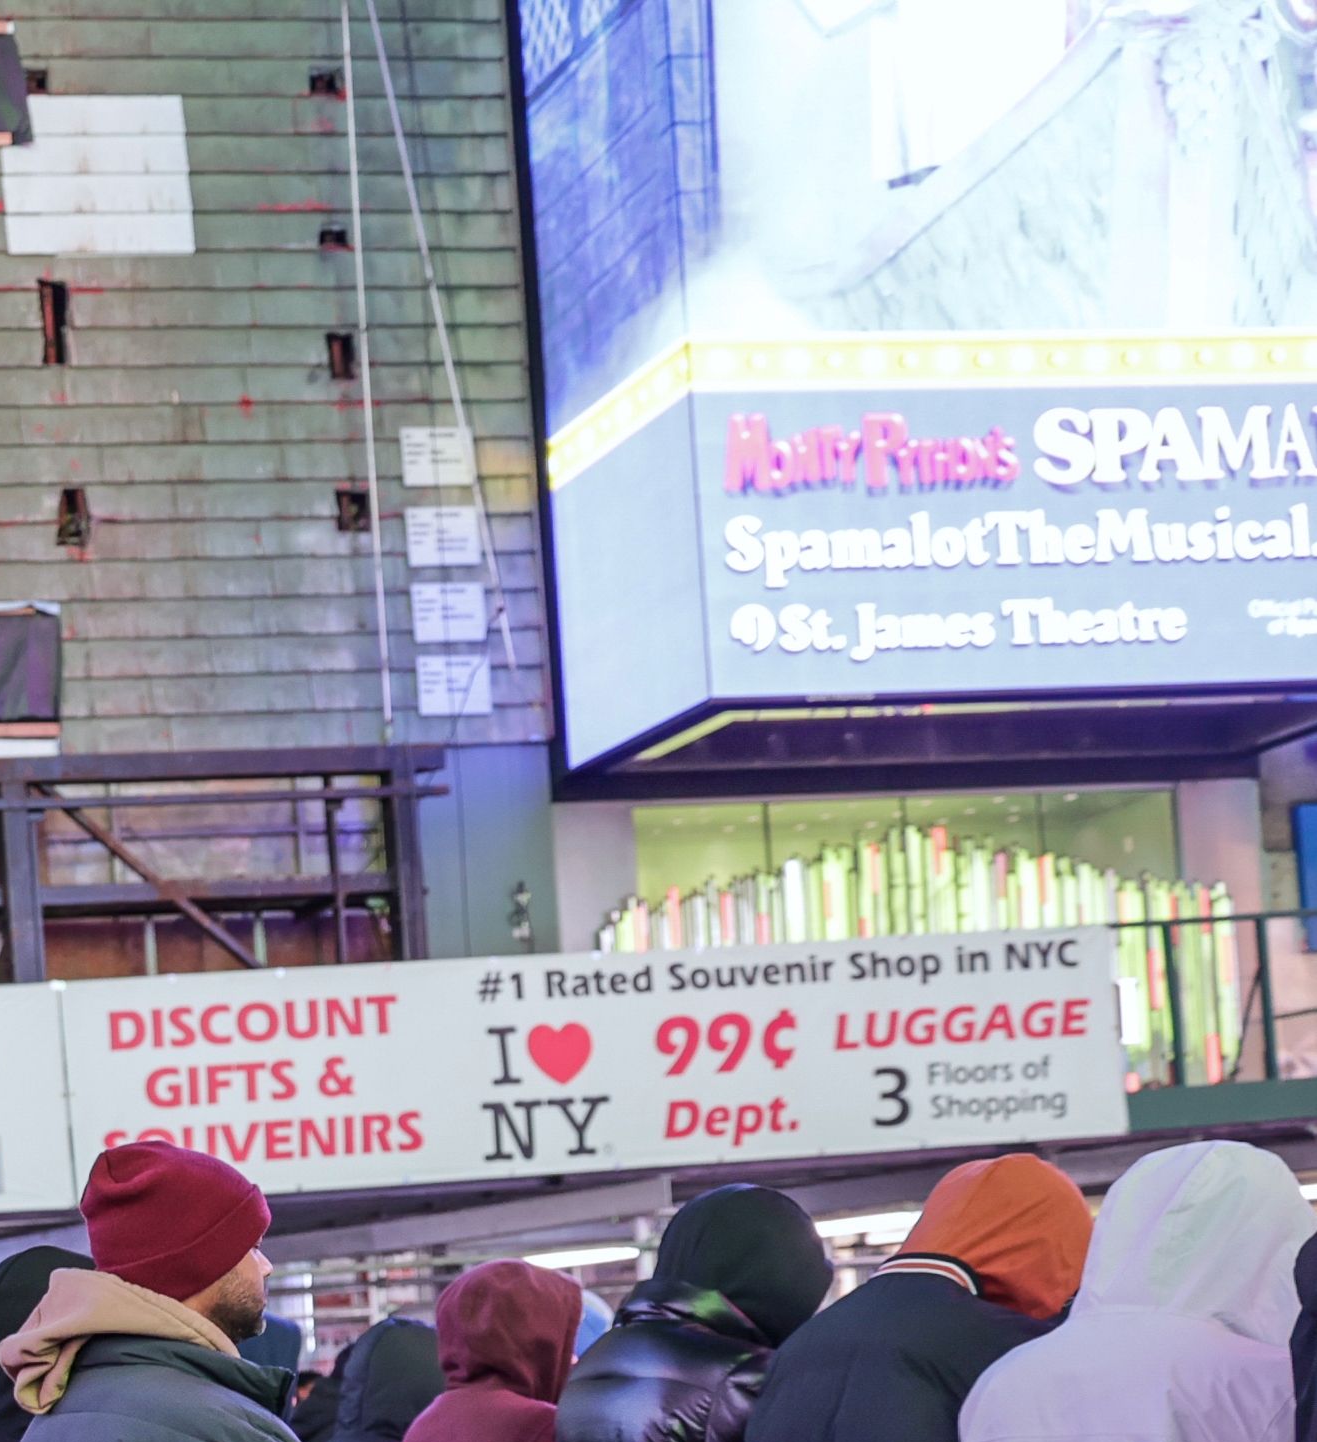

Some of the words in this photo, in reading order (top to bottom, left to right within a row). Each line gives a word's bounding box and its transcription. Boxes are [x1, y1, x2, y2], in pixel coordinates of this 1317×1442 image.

[1033, 403, 1317, 485] SPAMA
[779, 604, 847, 651] St.
[850, 602, 996, 661] James
[1001, 597, 1188, 645] Theatre
[478, 970, 524, 1002] #1
[546, 965, 653, 998] Rated
[669, 955, 834, 991] Souvenir
[850, 951, 941, 984] Shop
[957, 945, 989, 973] in
[1006, 939, 1078, 970] NYC
[109, 995, 397, 1050] DISCOUNT
[655, 1009, 797, 1078] 99¢
[834, 998, 1090, 1050] LUGGAGE
[146, 1060, 297, 1108] GIFTS
[318, 1056, 355, 1097] &
[488, 1026, 522, 1085] I
[928, 1061, 1013, 1085] Floors
[1023, 1055, 1052, 1082] of
[664, 1097, 800, 1147] Dept.
[873, 1066, 911, 1127] 3
[932, 1090, 1068, 1122] Shopping
[482, 1096, 610, 1162] NY
